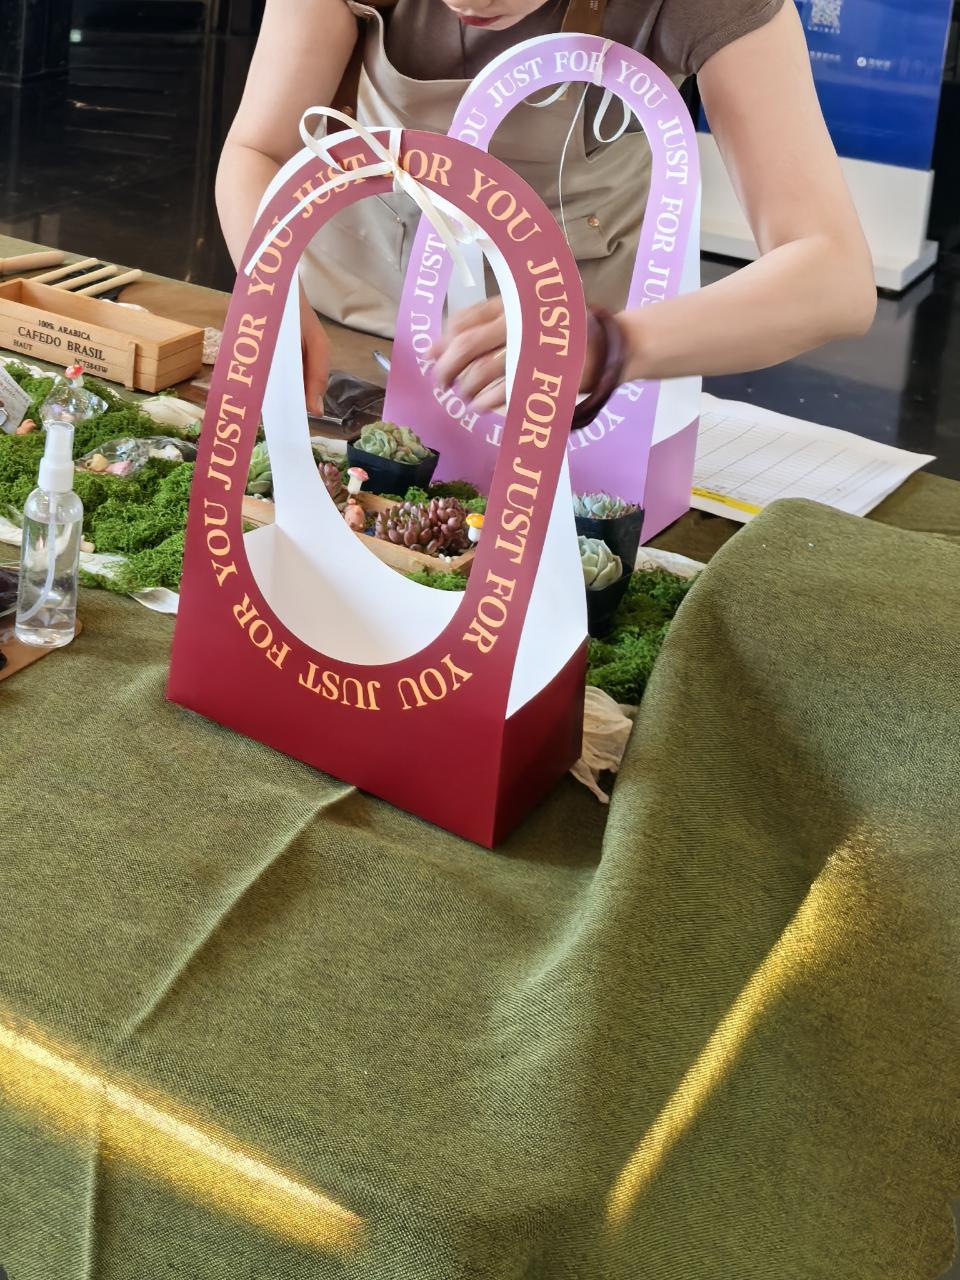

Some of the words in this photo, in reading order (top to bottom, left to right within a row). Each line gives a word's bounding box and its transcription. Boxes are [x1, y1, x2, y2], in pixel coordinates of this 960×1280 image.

[487, 56, 543, 108] JUST
[616, 60, 667, 109] YOU
[457, 108, 488, 146] OU
[657, 116, 688, 185] JUST
[292, 153, 368, 218] JUST
[383, 149, 453, 187] OR
[466, 168, 542, 242] YOU
[652, 194, 683, 254] FOR
[247, 216, 293, 296] YOU
[414, 233, 448, 304] JUST
[38, 320, 55, 330] 100%
[58, 325, 91, 340] ARABICA
[527, 257, 570, 356] JUST
[13, 339, 33, 351] HAUT
[18, 326, 62, 347] CAFEDO
[67, 340, 106, 361] BRASIL
[227, 312, 268, 388] FOR
[207, 393, 247, 491] JUST
[518, 367, 563, 449] FOR
[204, 501, 238, 588] YOU
[495, 456, 542, 565] JUST
[232, 592, 292, 670] FOR
[462, 569, 516, 654] FOR
[298, 660, 381, 711] JUST
[397, 654, 473, 710] YOU
